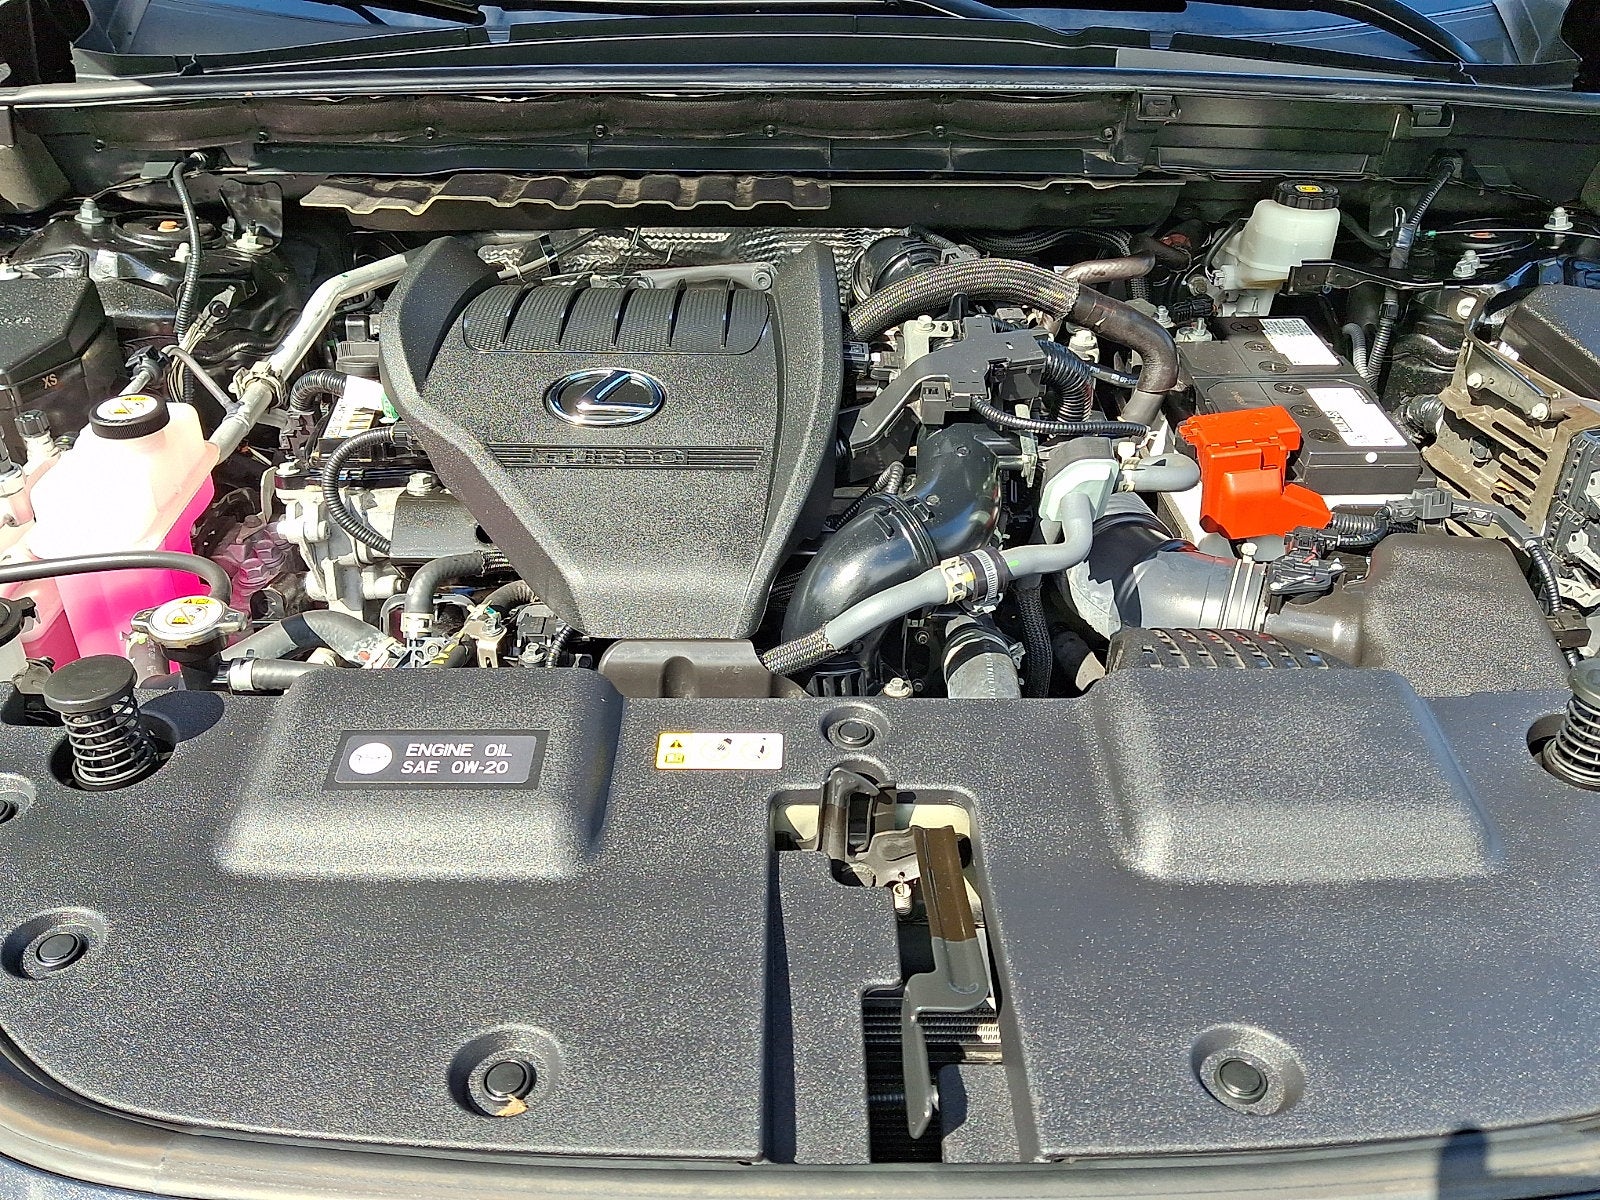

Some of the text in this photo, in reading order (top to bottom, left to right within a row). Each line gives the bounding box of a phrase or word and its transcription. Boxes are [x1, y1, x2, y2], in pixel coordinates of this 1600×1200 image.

[42, 373, 58, 389] XS
[536, 448, 685, 465] TURBO
[405, 743, 512, 757] ENGINE OIL
[400, 760, 440, 774] SAE
